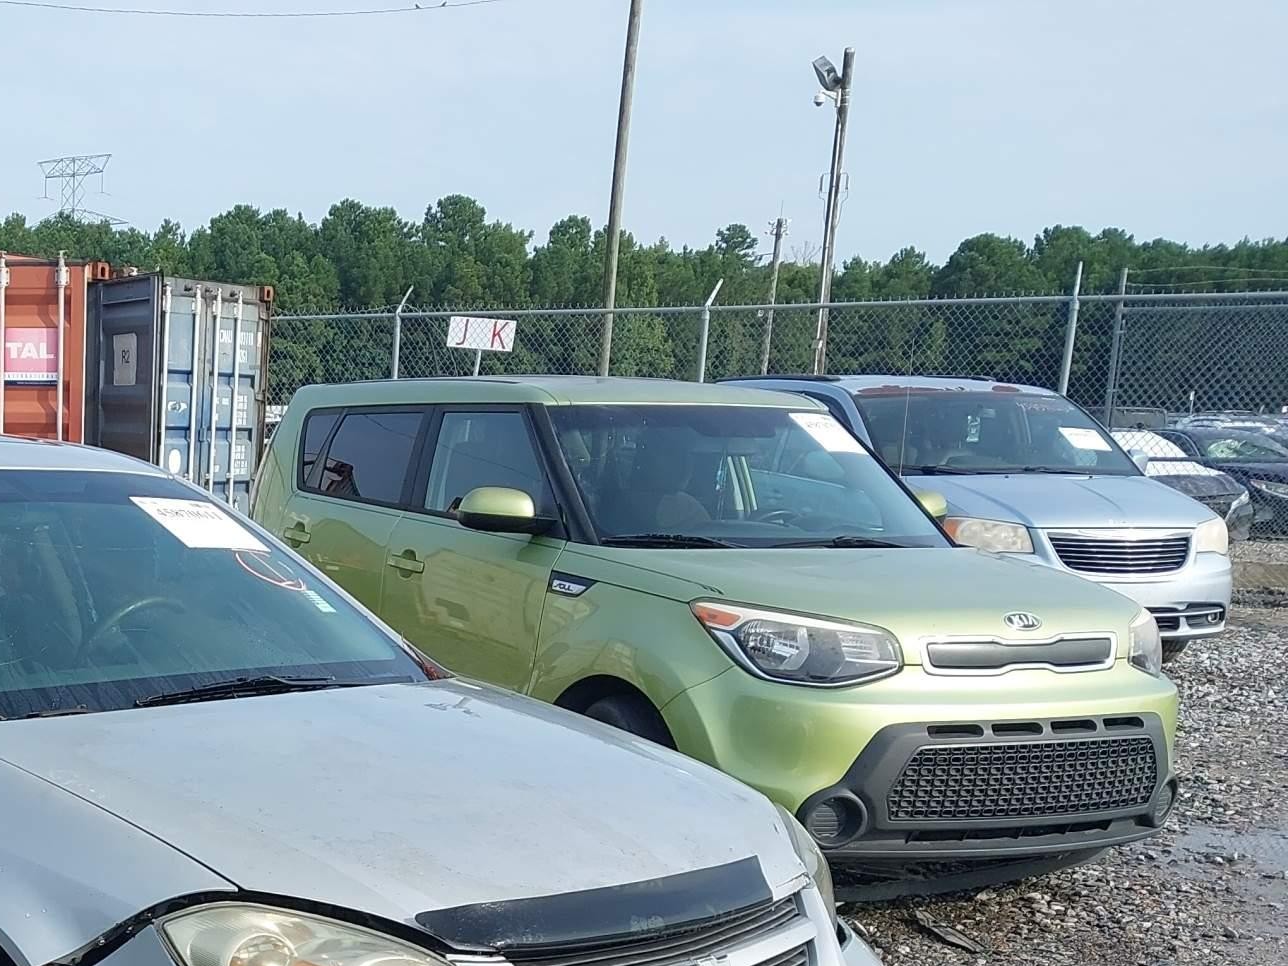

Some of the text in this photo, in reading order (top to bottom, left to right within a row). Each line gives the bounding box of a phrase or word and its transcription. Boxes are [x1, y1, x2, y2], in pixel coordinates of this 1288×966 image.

[490, 320, 509, 350] K
[5, 342, 57, 359] TAL
[1006, 613, 1040, 628] KIA
